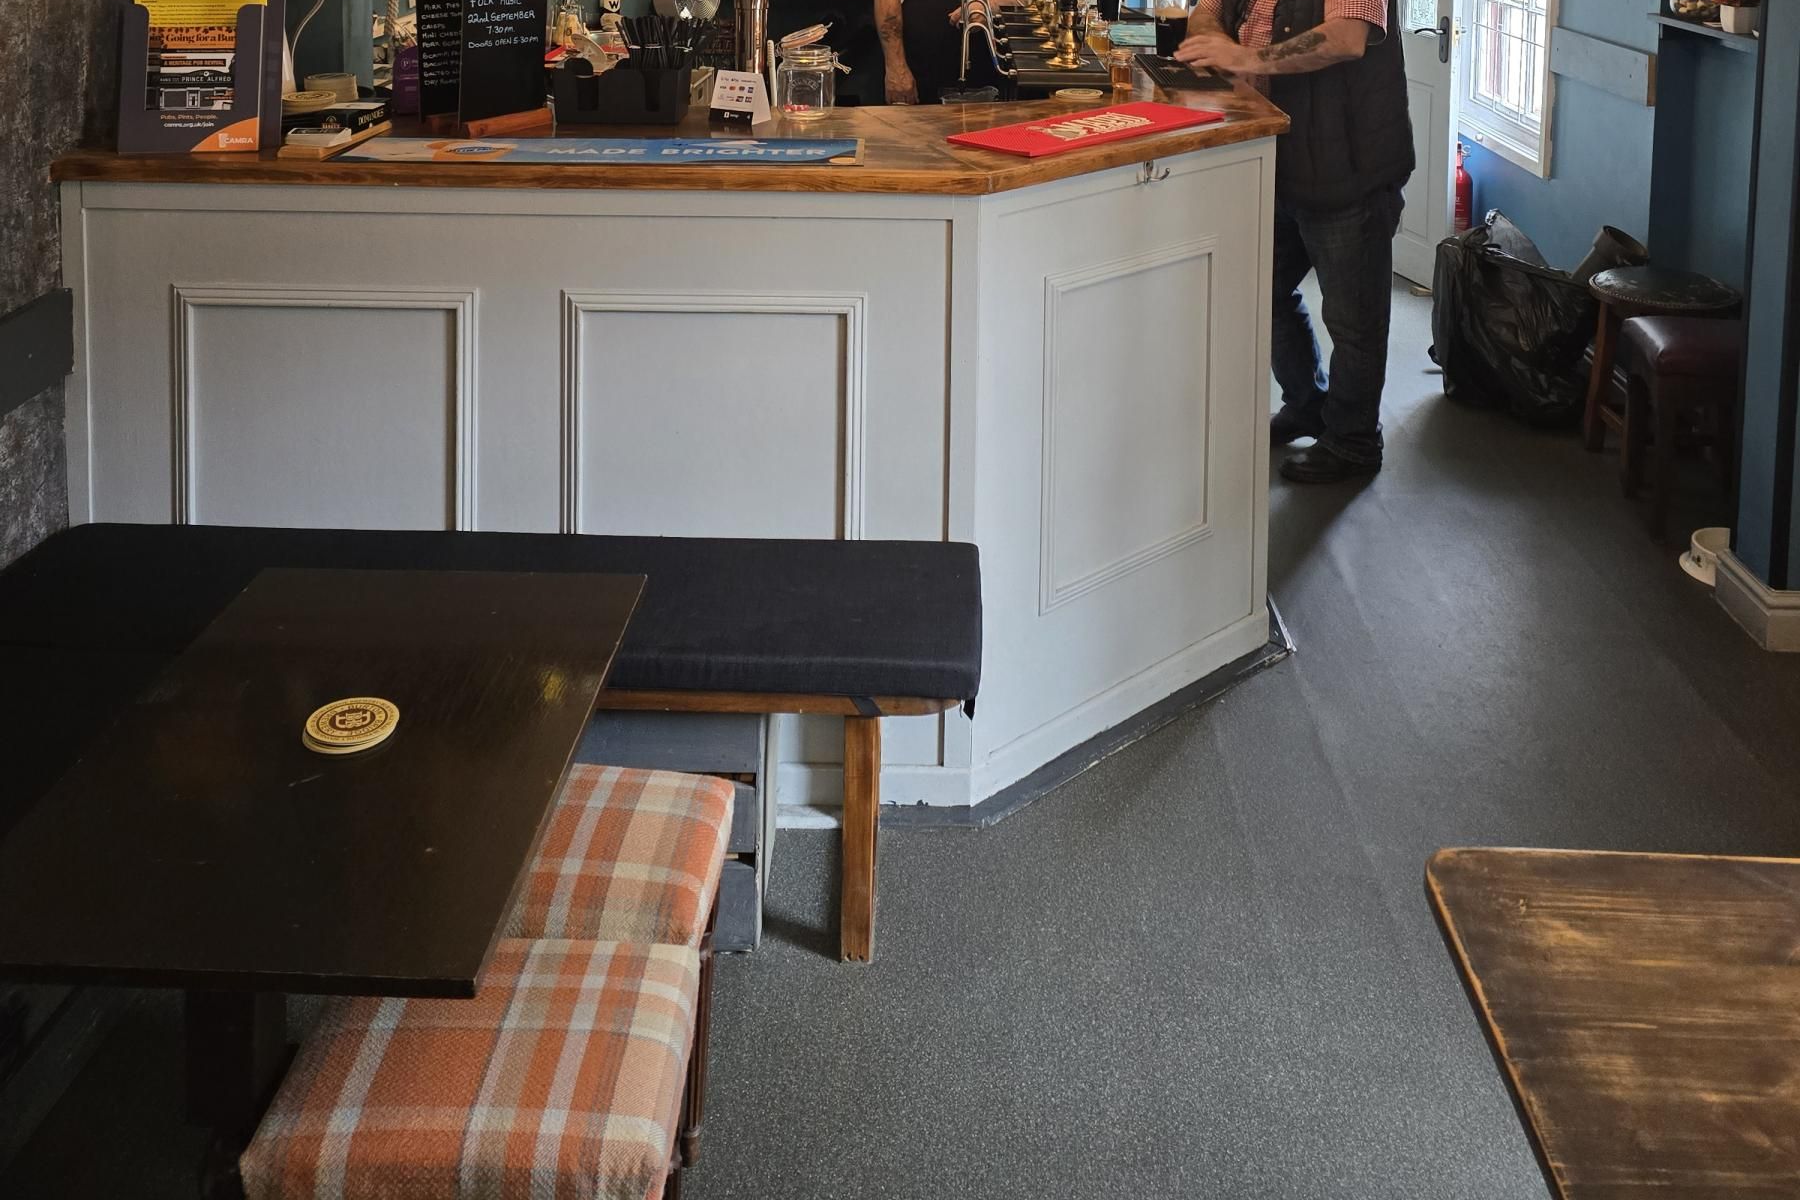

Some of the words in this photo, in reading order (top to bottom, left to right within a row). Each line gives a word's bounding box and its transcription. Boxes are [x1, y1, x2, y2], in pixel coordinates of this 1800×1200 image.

[421, 12, 448, 20] CHEESE
[467, 14, 490, 24] 22nd
[490, 9, 536, 23] SEPTEMBER
[166, 33, 195, 43] Going
[196, 33, 208, 41] for
[468, 40, 493, 49] DOORS
[495, 38, 512, 46] OPEN
[224, 136, 254, 144] CAMRA
[546, 147, 647, 156] MADE
[660, 147, 826, 157] BRIGHTER
